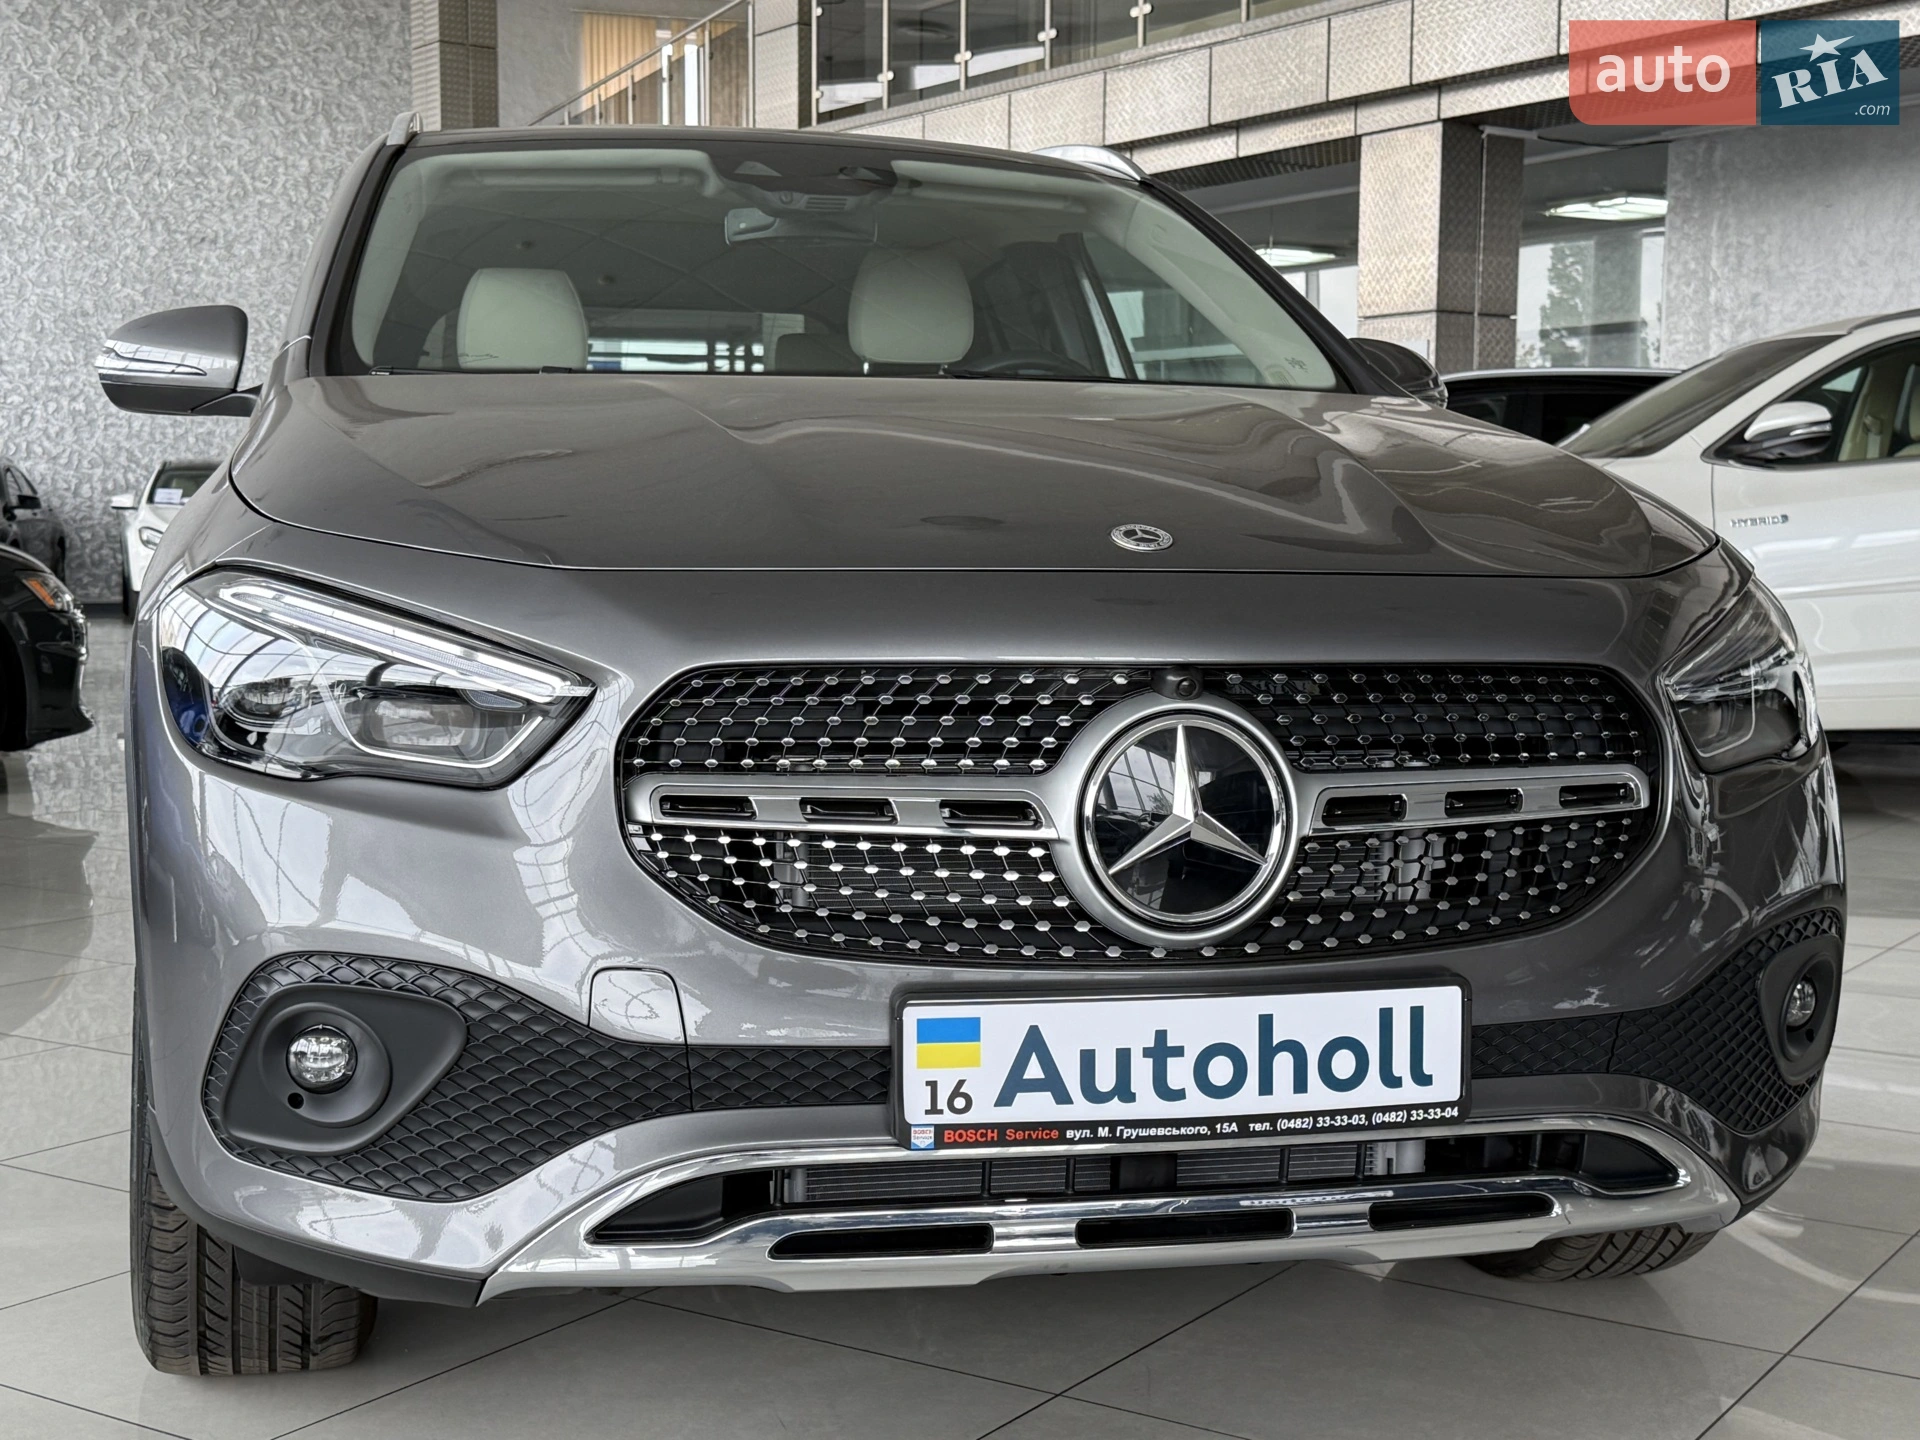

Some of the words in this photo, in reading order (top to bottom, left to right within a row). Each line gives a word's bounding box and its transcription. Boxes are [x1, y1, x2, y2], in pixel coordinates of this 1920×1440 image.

[993, 1005, 1433, 1108] Autoholl
[924, 1079, 973, 1116] 16
[944, 1129, 998, 1143] BOSCH
[1005, 1127, 1059, 1141] Service
[1066, 1128, 1093, 1141] вул.
[1097, 1126, 1112, 1138] М.
[1116, 1122, 1211, 1140] Грушевського,
[1248, 1121, 1273, 1132] тел.
[1277, 1116, 1313, 1132] (0482)
[1316, 1114, 1368, 1128] 33-33-03,
[1372, 1110, 1407, 1125] (0482)
[1410, 1107, 1459, 1121] 33-33-04
